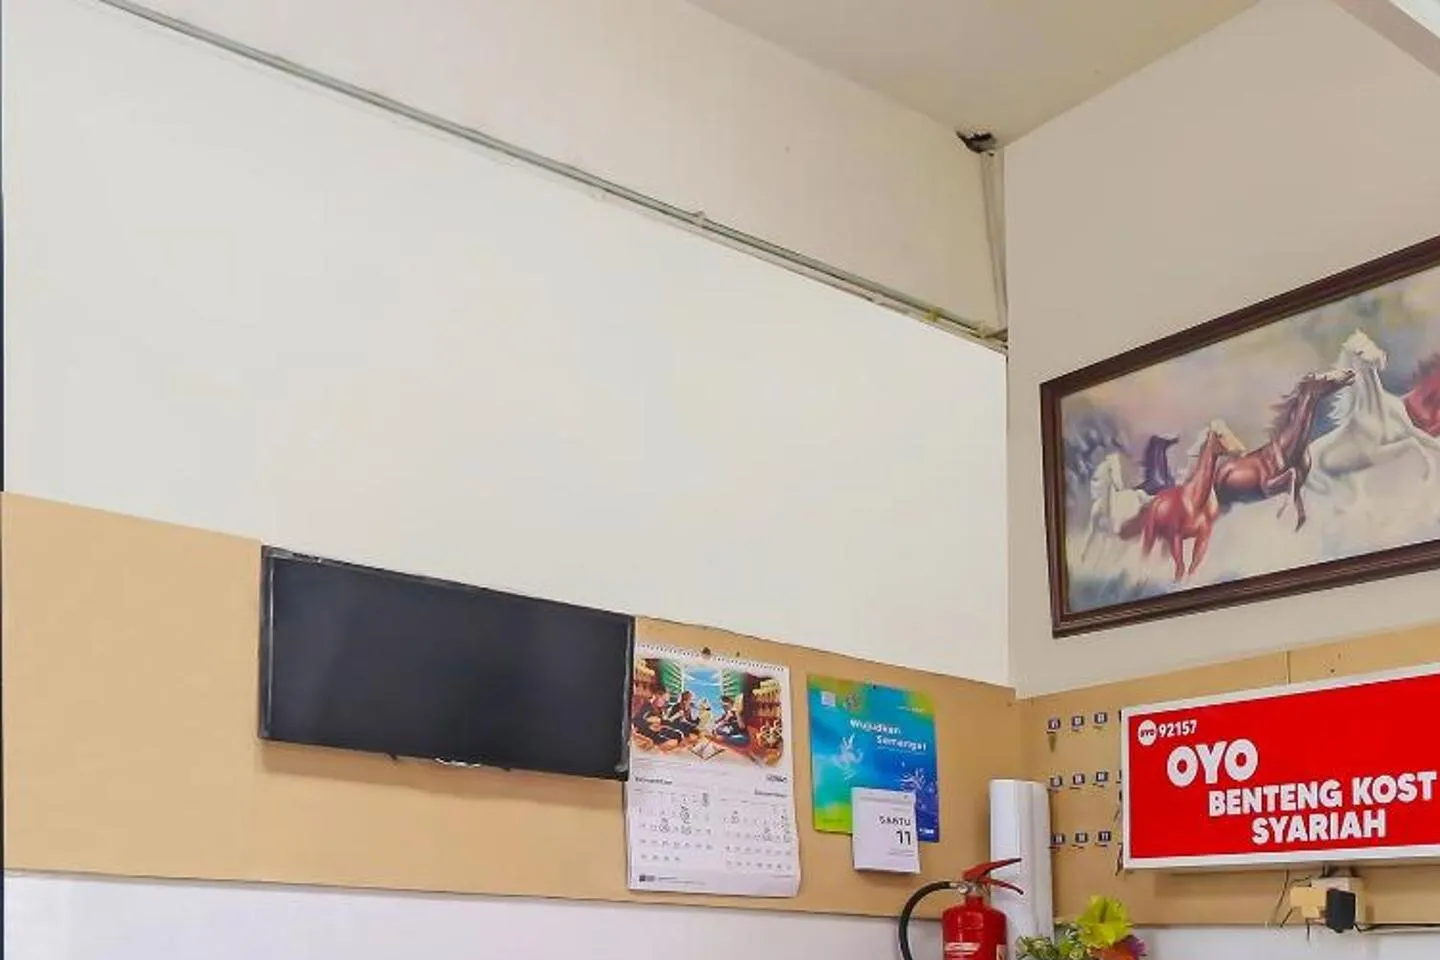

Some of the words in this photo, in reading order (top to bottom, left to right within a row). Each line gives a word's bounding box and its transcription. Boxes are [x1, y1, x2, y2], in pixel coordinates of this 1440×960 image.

[1159, 719, 1197, 738] 92157
[1167, 738, 1259, 787] OYO
[1208, 779, 1343, 817] BENTENG
[1352, 771, 1438, 806] KOST
[896, 830, 911, 846] 11
[1252, 808, 1387, 845] SYARIAH
